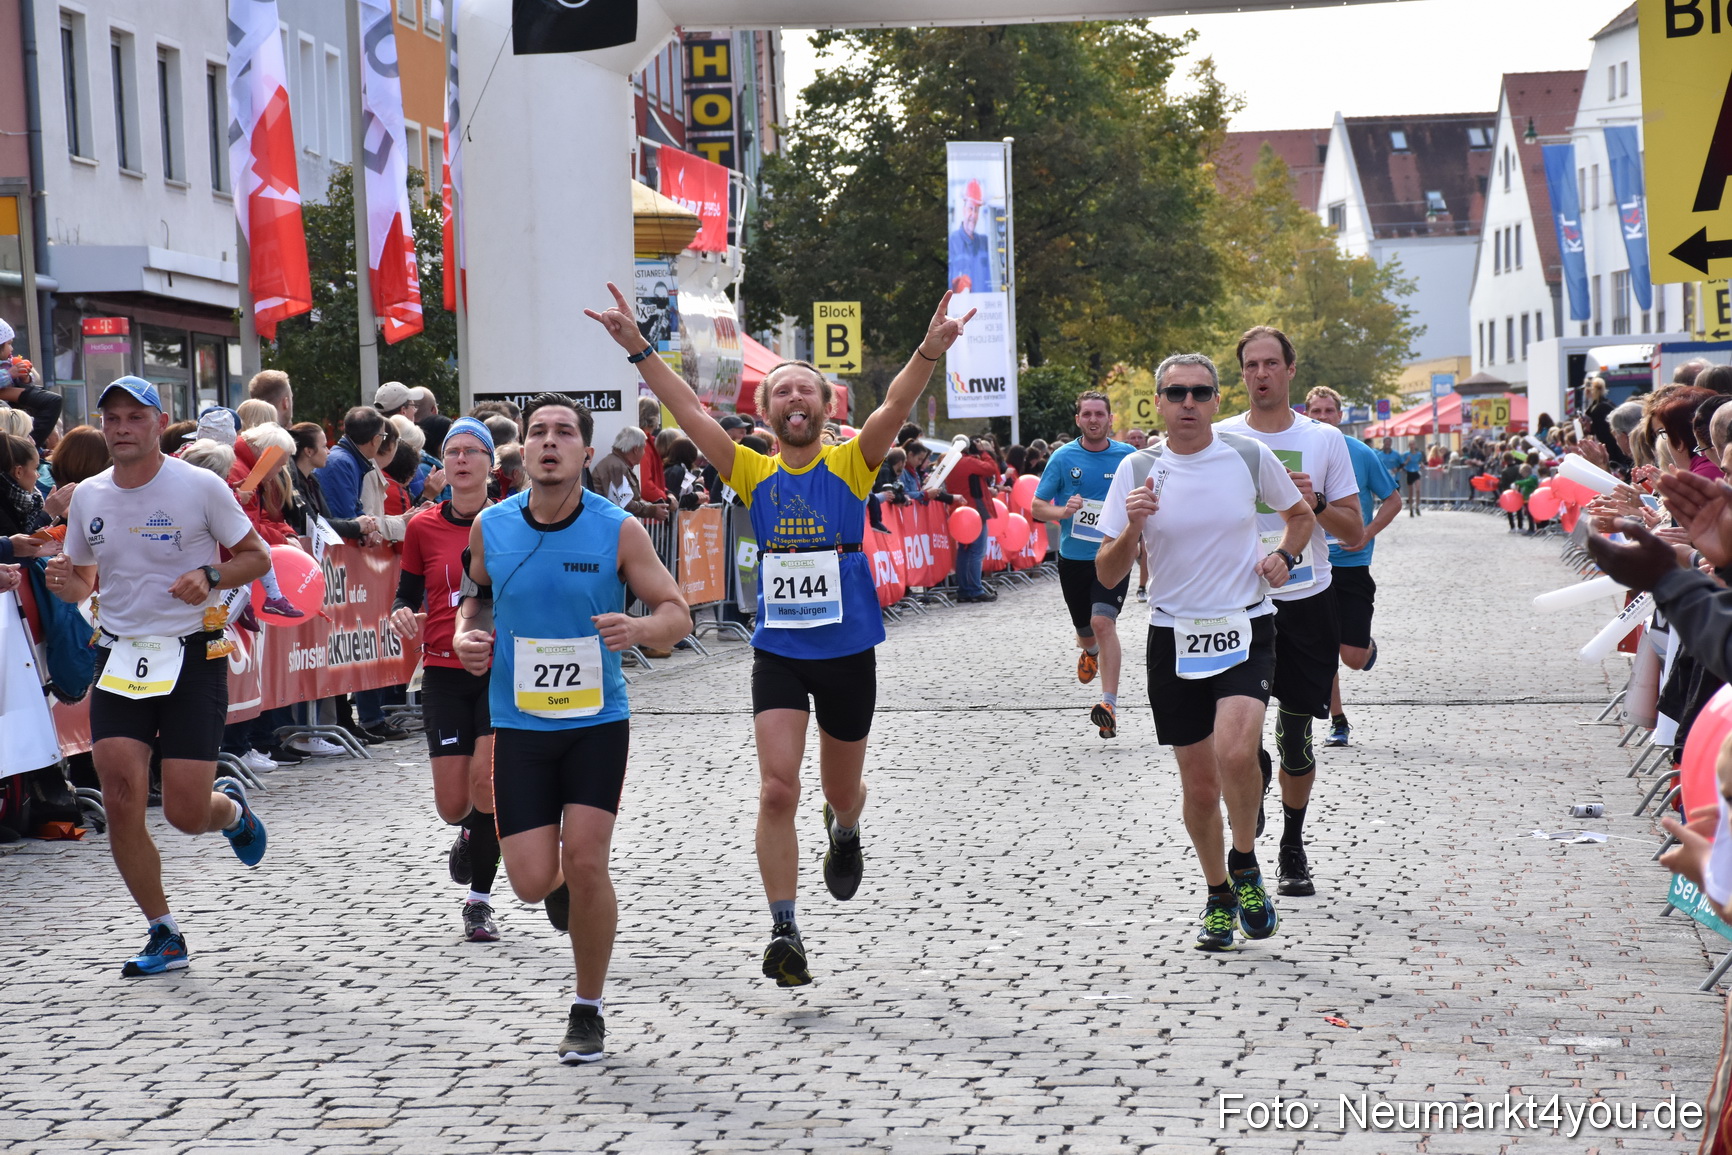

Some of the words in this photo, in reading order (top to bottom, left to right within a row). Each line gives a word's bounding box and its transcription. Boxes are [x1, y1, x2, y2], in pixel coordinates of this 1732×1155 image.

[1665, 0, 1732, 39] Bl
[691, 45, 732, 166] HOT
[819, 305, 855, 318] Block
[826, 324, 850, 357] B
[1133, 388, 1154, 397] Block
[1137, 398, 1151, 418] C
[1495, 406, 1507, 421] D
[88, 534, 105, 542] PARTL
[563, 562, 600, 573] THULE
[772, 575, 829, 600] 2144
[778, 606, 828, 617] Hans-Jürgen
[1186, 630, 1242, 654] 2768
[544, 646, 575, 654] BOCK
[135, 656, 149, 679] 6
[533, 662, 582, 688] 272
[127, 683, 149, 692] Peter
[547, 695, 570, 705] Sven
